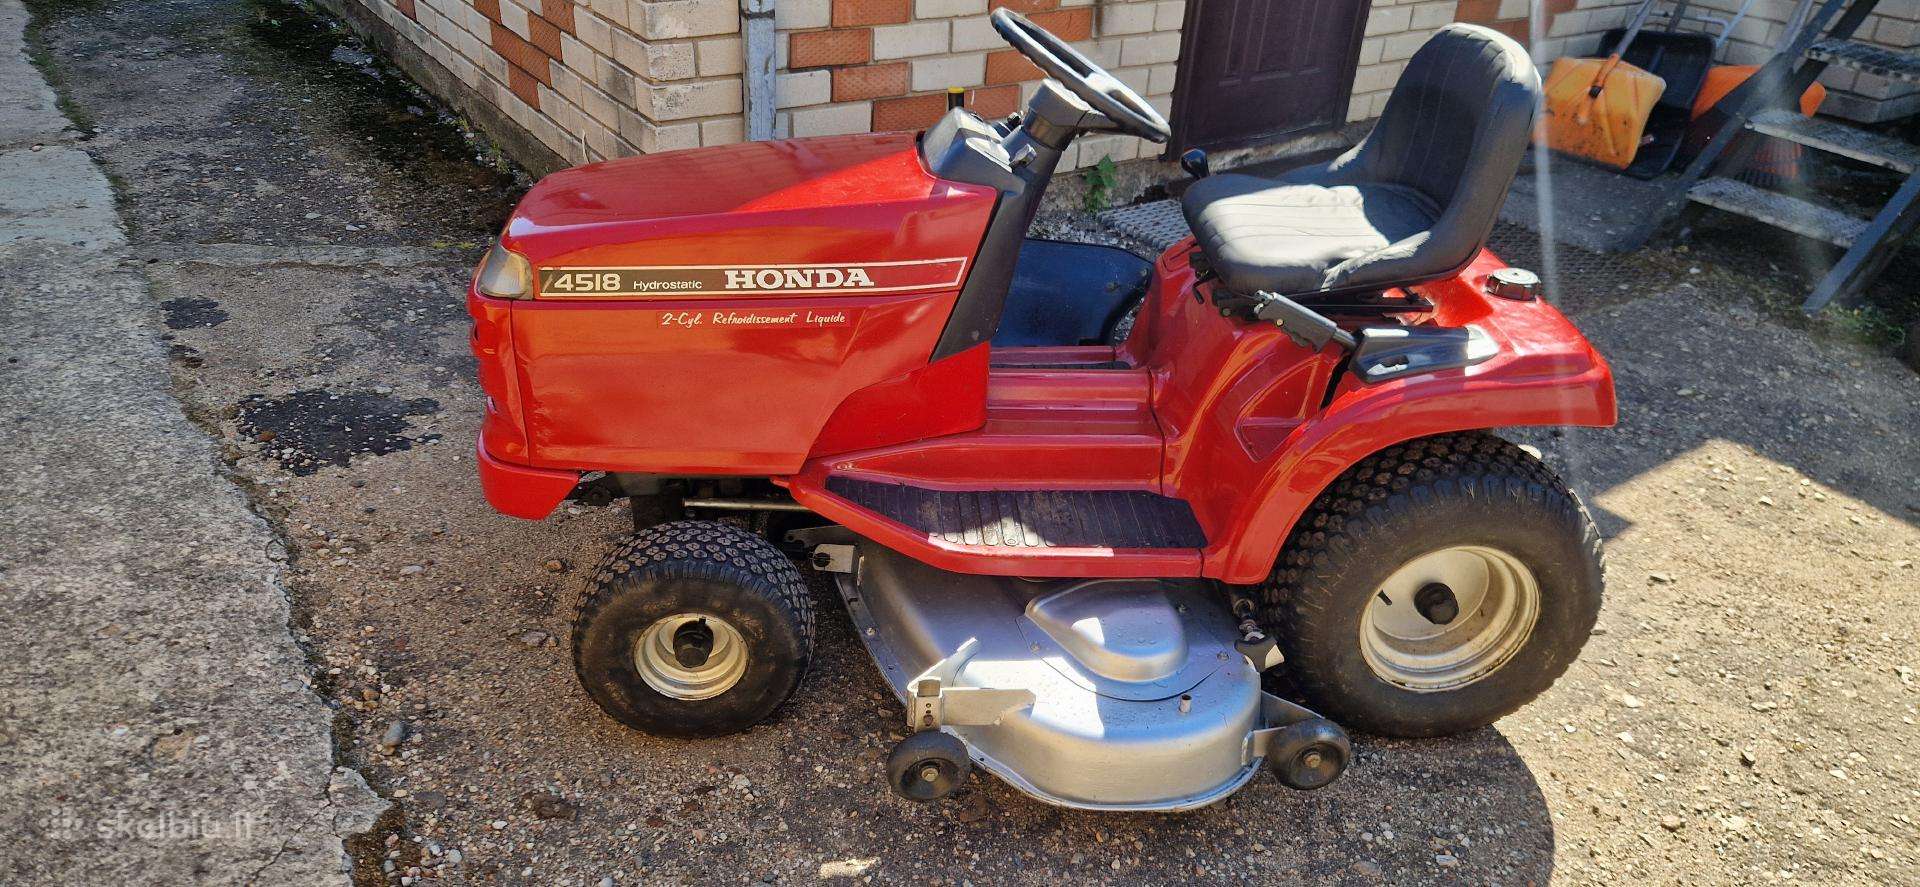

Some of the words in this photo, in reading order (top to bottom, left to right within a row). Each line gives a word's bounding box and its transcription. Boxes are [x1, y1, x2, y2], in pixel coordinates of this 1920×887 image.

[633, 280, 703, 291] Hydrostatic
[724, 268, 875, 290] HONDA
[662, 312, 703, 328] 2-Cyl.
[712, 312, 798, 325] Refroidissement
[806, 310, 846, 327] Liquide
